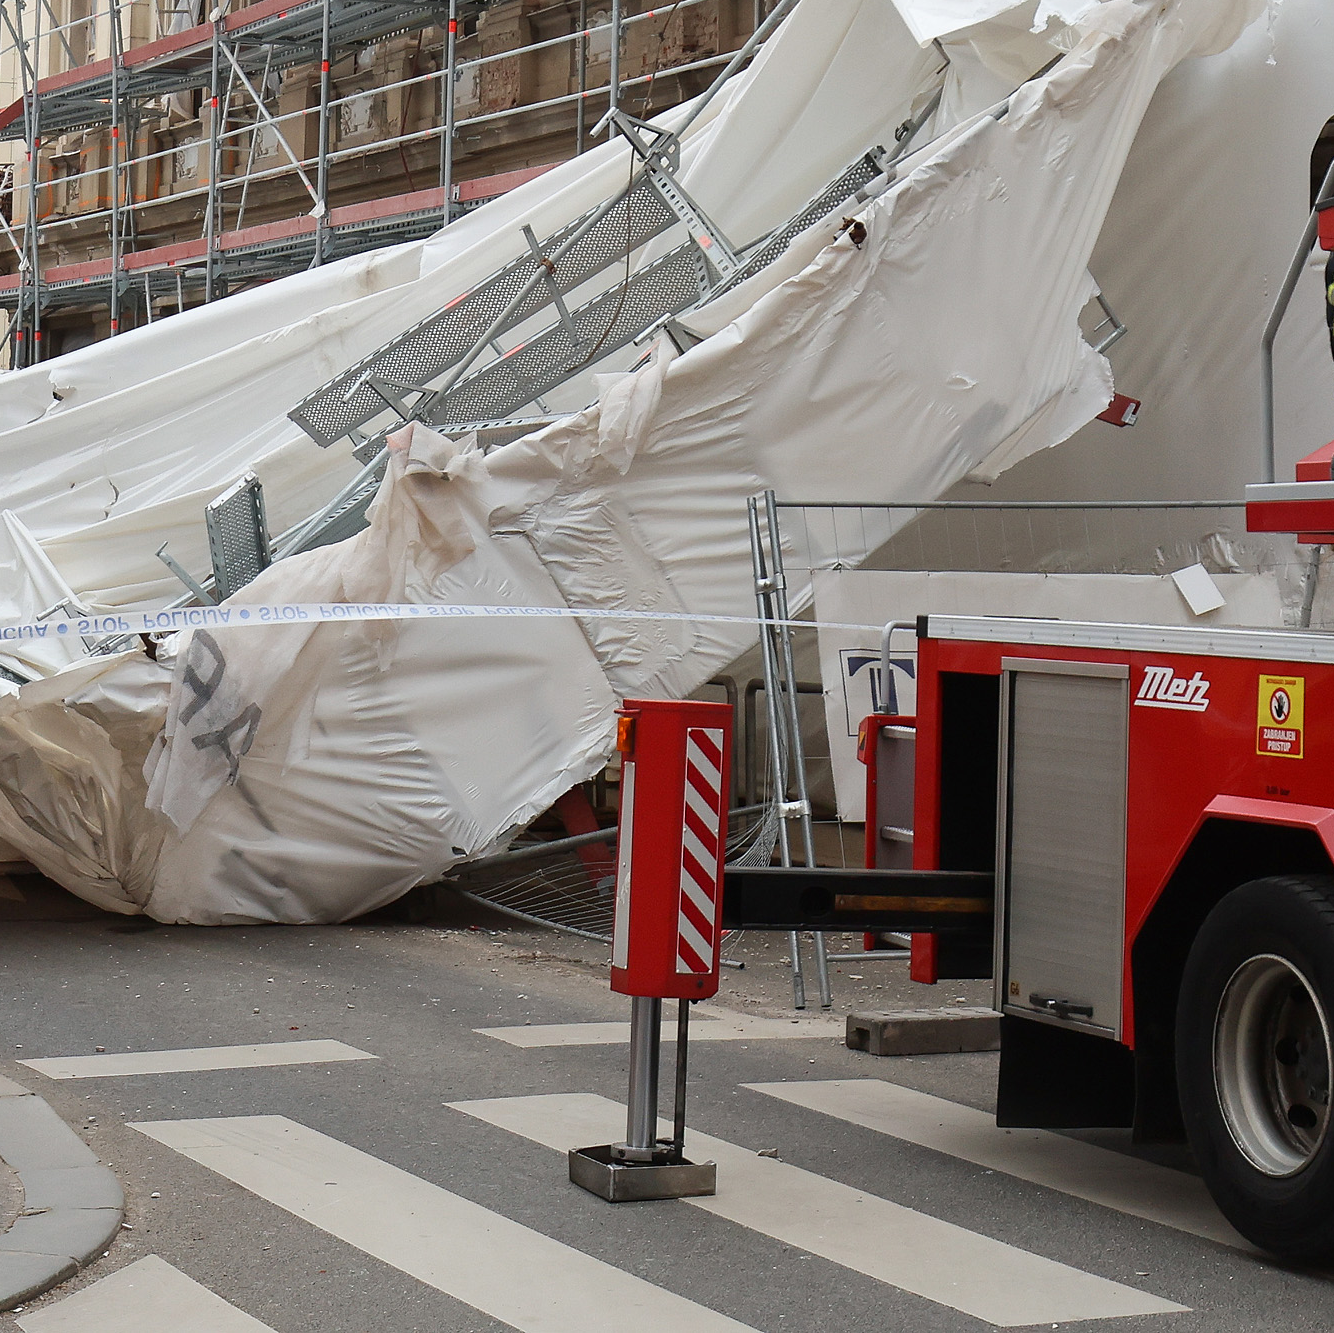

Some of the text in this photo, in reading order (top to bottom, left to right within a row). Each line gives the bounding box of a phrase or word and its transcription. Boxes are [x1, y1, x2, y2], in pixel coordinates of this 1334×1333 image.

[1134, 666, 1210, 712] Metz
[1263, 729, 1296, 741] ZABRANJEN
[1267, 741, 1292, 752] PRISTUP
